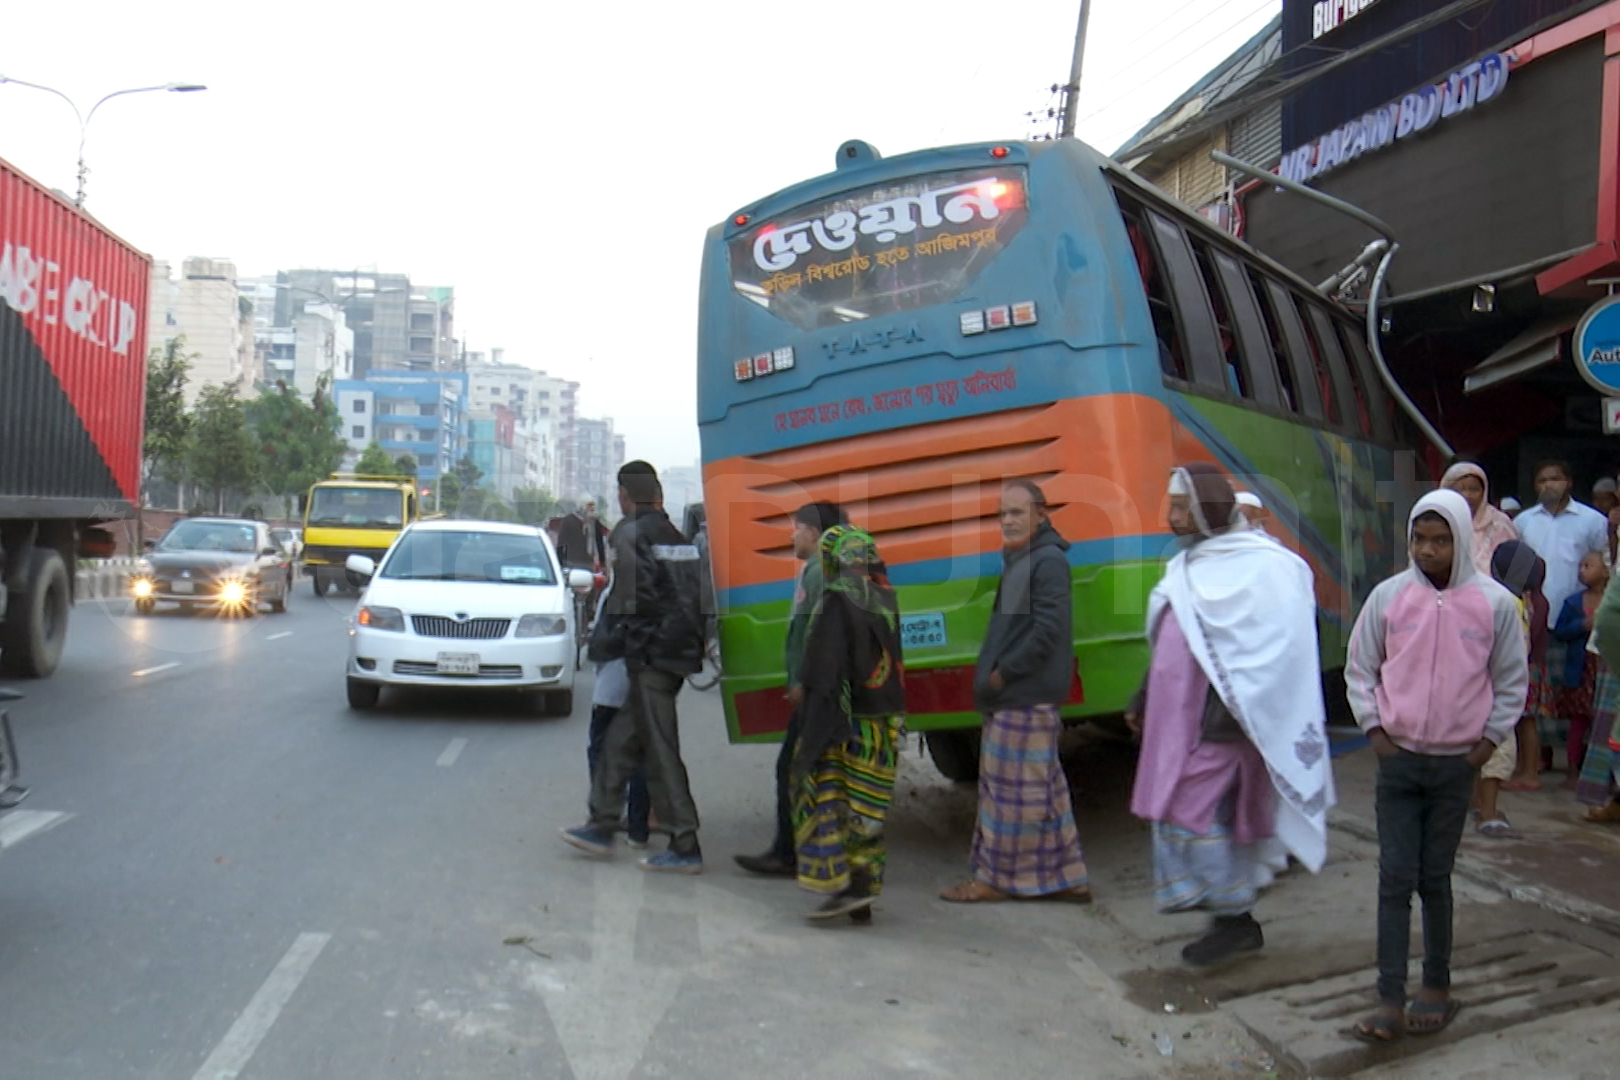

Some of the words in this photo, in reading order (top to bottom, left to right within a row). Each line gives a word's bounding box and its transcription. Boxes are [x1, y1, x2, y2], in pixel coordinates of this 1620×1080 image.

[1313, 103, 1398, 176] JAPAN
[1441, 52, 1509, 118] LTD
[753, 177, 999, 271] দেওয়ান
[875, 246, 910, 268] হতে
[914, 227, 997, 256] আজিমপুর
[820, 322, 925, 360] TATA
